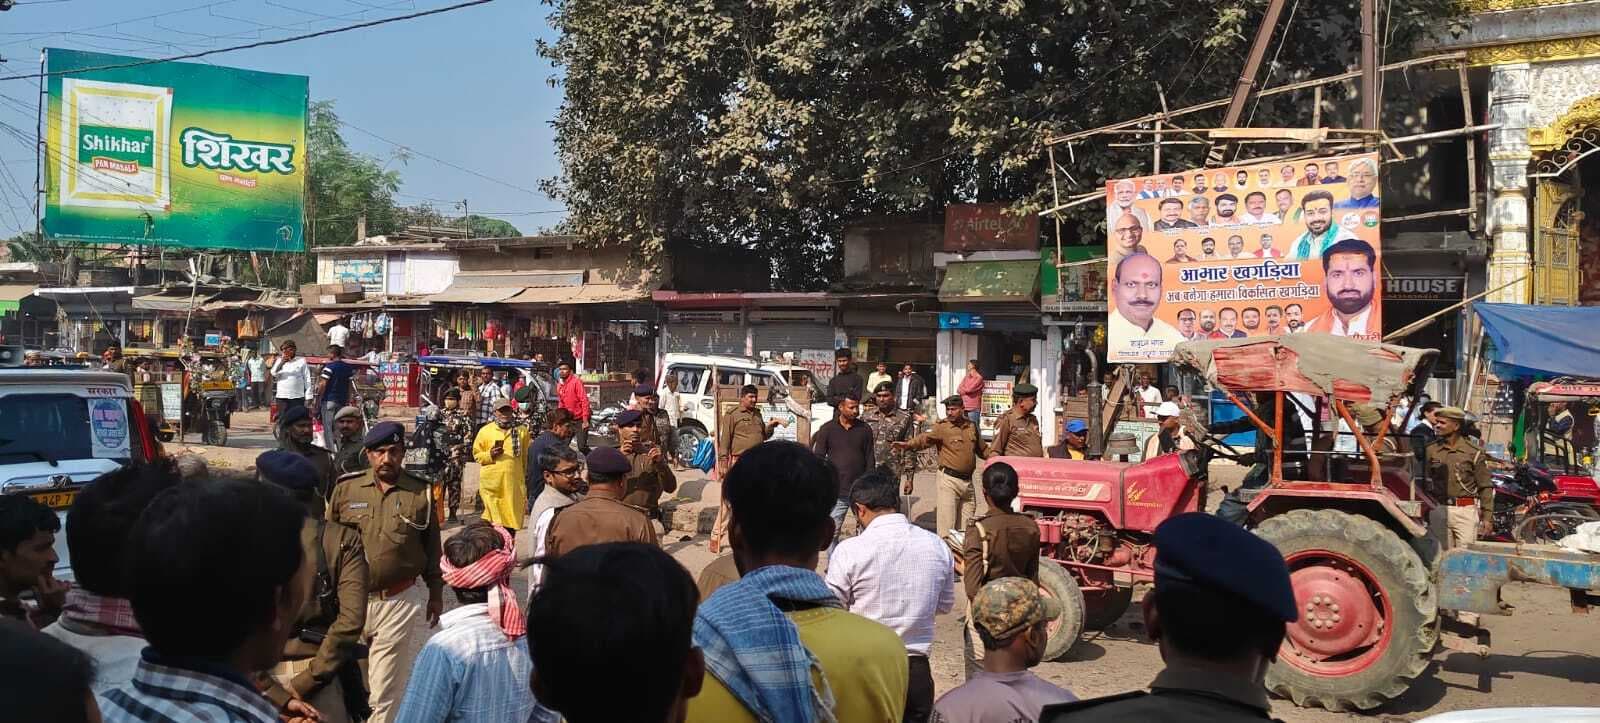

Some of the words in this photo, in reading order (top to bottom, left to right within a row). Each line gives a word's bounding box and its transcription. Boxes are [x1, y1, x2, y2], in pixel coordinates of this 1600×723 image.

[181, 128, 294, 173] शिखर
[95, 159, 108, 169] PAN
[1233, 260, 1300, 281] खगड़िया
[1167, 291, 1180, 302] अब
[1183, 287, 1207, 301] बनेगा
[1209, 289, 1235, 300] हमारा
[1238, 284, 1276, 300] विकसित
[1279, 283, 1319, 298] खगड़िया
[1387, 279, 1457, 293] HOUSE
[87, 387, 117, 396] सरकार
